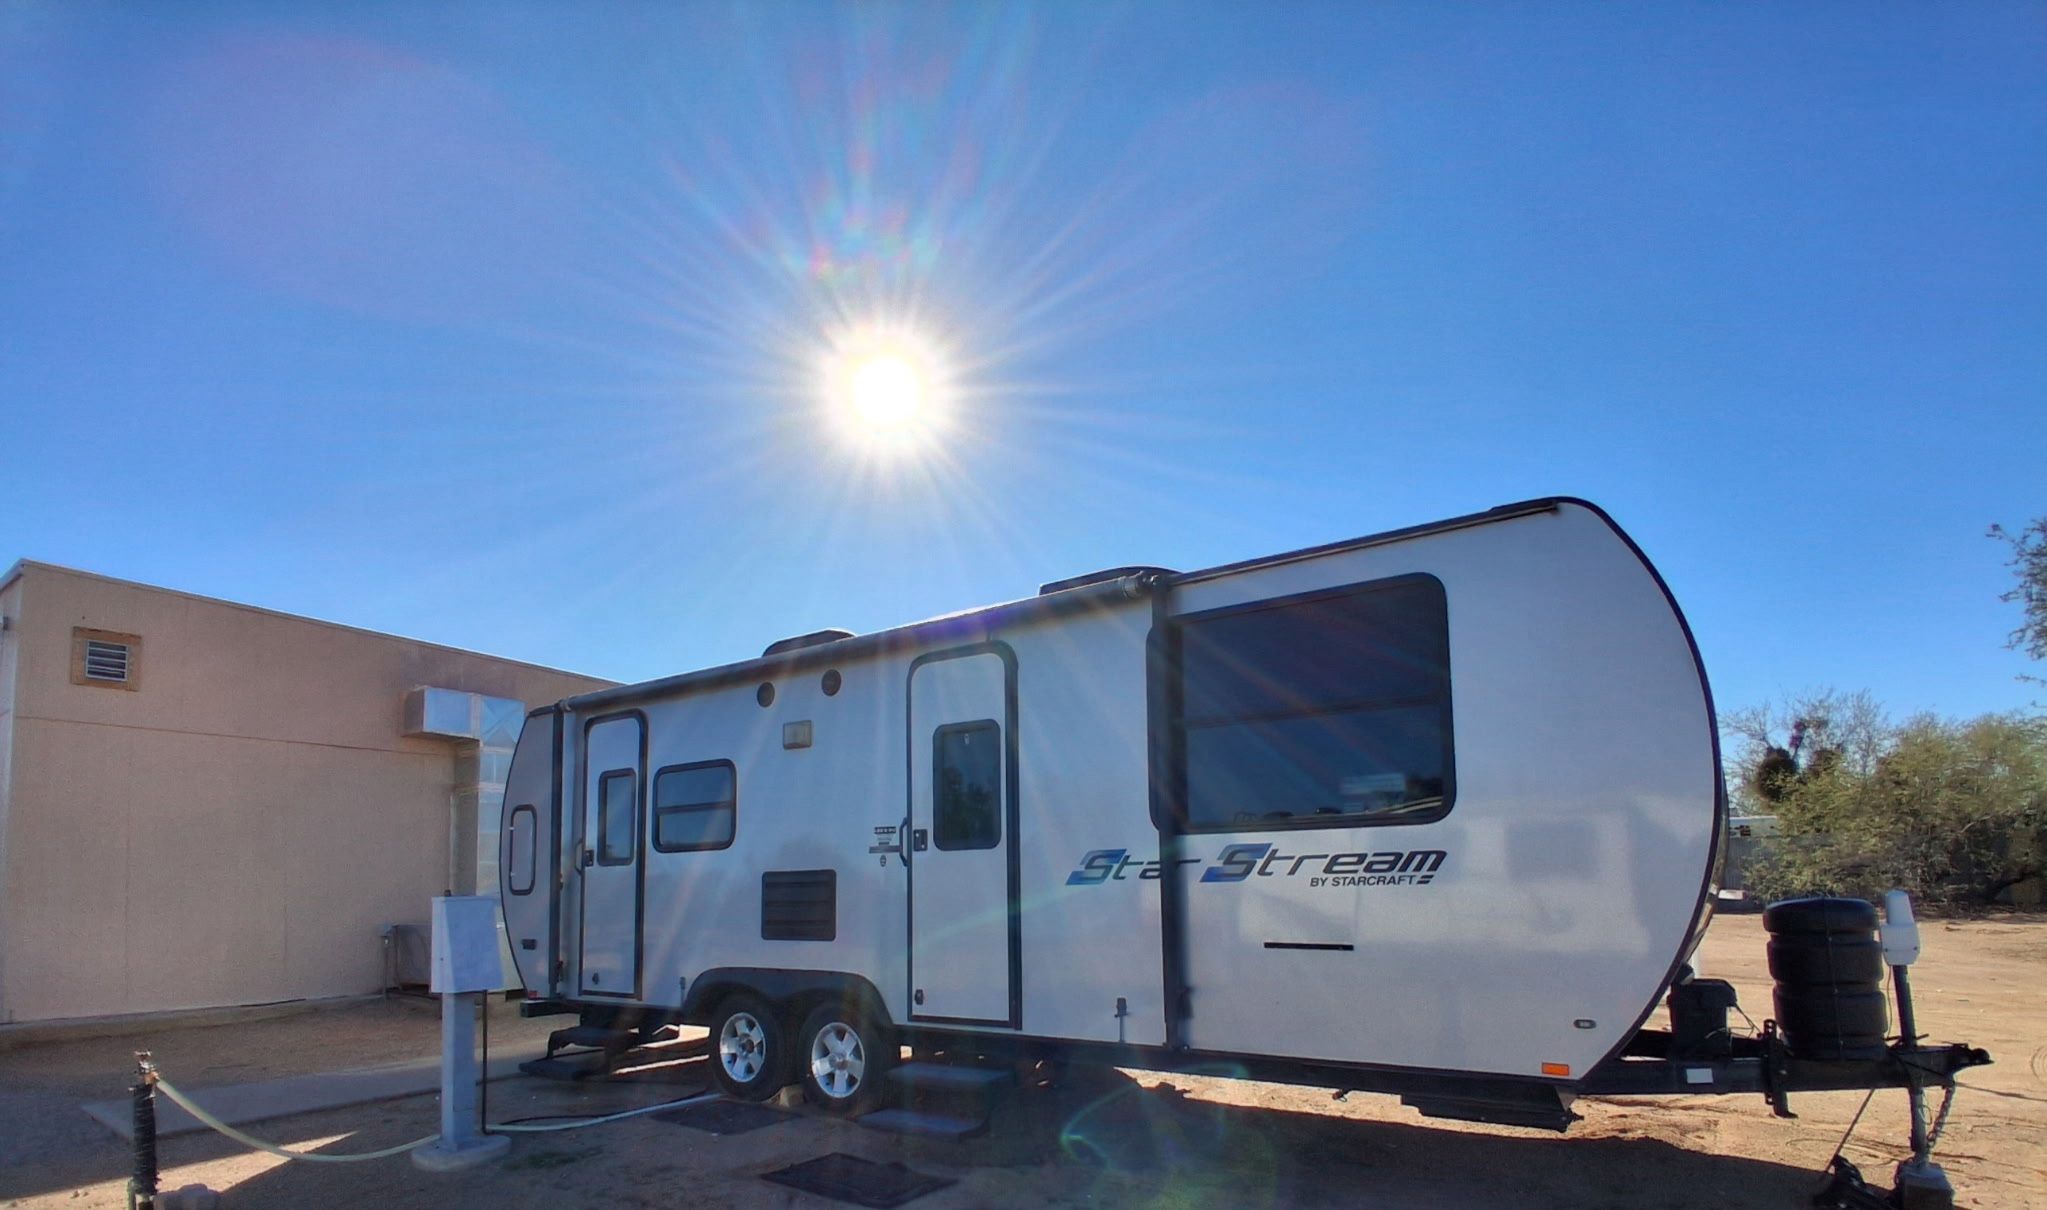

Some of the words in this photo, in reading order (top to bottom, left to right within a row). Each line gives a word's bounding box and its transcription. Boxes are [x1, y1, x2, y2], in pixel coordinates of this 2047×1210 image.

[1199, 843, 1447, 883] Stream
[1309, 876, 1328, 887] BY
[1331, 874, 1416, 887] STARCRAFT
